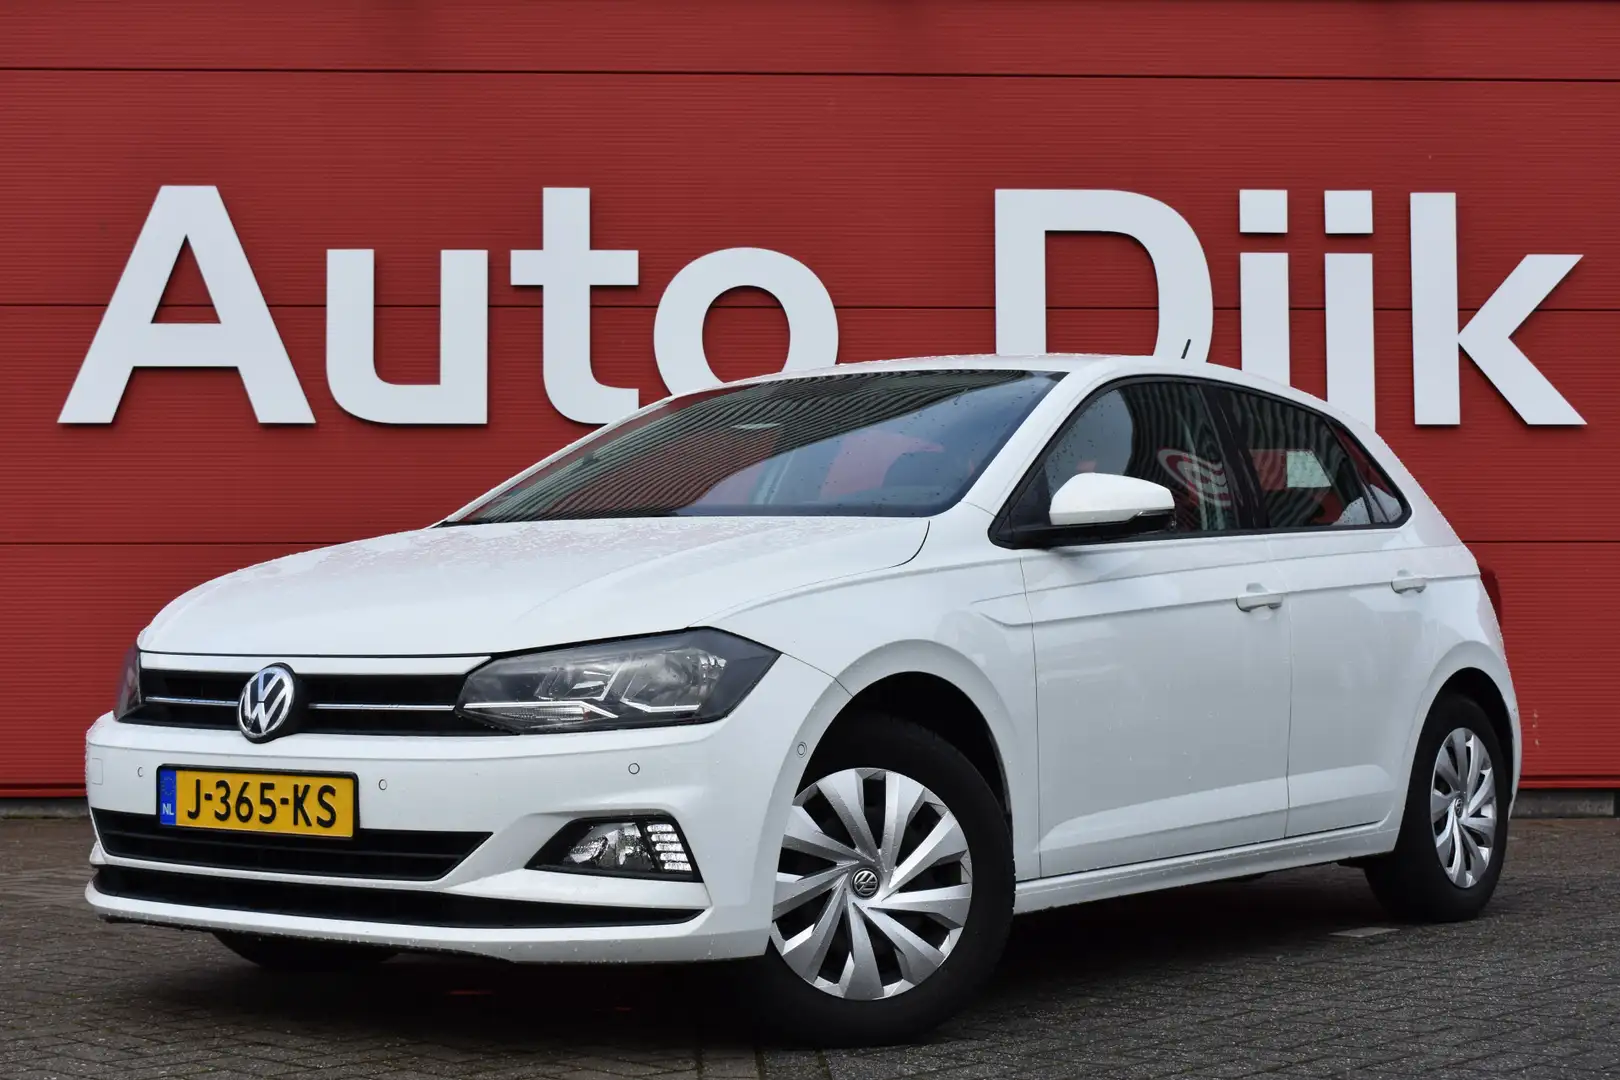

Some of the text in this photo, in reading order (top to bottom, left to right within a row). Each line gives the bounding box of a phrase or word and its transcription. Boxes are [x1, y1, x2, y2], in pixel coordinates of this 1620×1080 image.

[57, 185, 1587, 431] Auto Dijk
[162, 802, 175, 816] NL
[187, 778, 337, 828] J-365-KS
